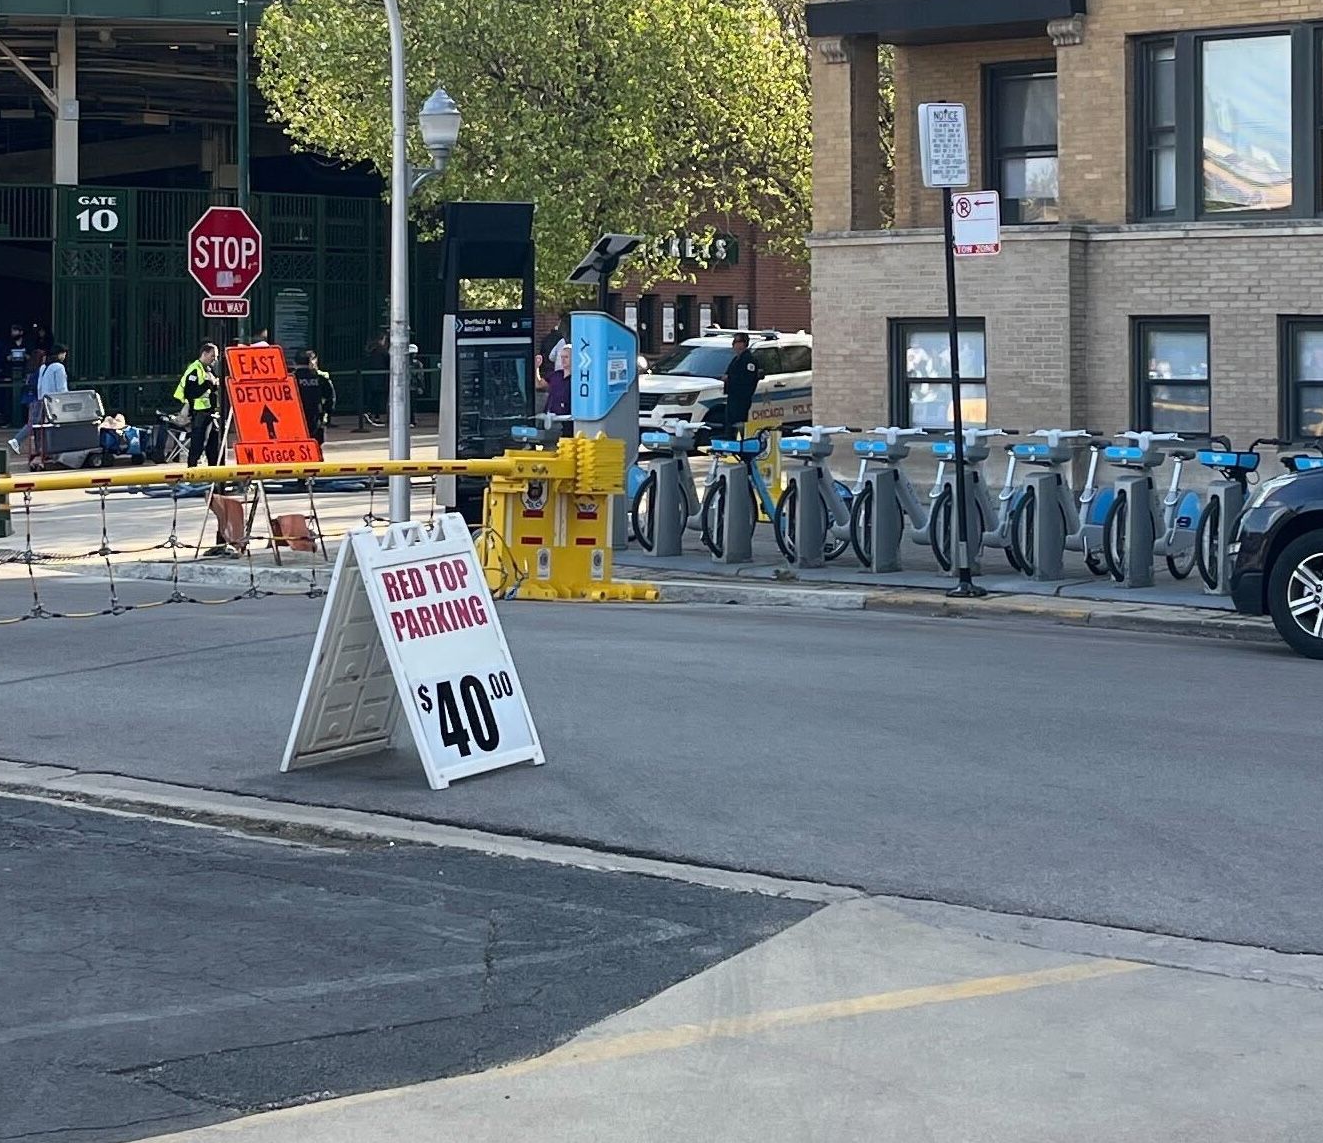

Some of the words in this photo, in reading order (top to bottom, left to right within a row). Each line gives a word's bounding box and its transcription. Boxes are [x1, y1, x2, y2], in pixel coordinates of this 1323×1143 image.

[933, 110, 959, 121] NOTICE
[77, 196, 117, 206] GATE
[76, 208, 118, 232] 10
[194, 235, 256, 270] STOP
[957, 245, 973, 254] TOW
[976, 244, 996, 254] ZONE
[207, 303, 224, 314] ALL
[227, 303, 244, 314] WAY
[238, 353, 277, 375] EAST
[299, 378, 319, 386] POLICE
[236, 385, 294, 403] DETOUR
[752, 407, 785, 421] CHICAGO
[261, 447, 296, 462] Grace
[299, 444, 313, 461] St
[381, 567, 427, 603] RED
[425, 559, 468, 594] TOP
[390, 595, 488, 642] PARKING
